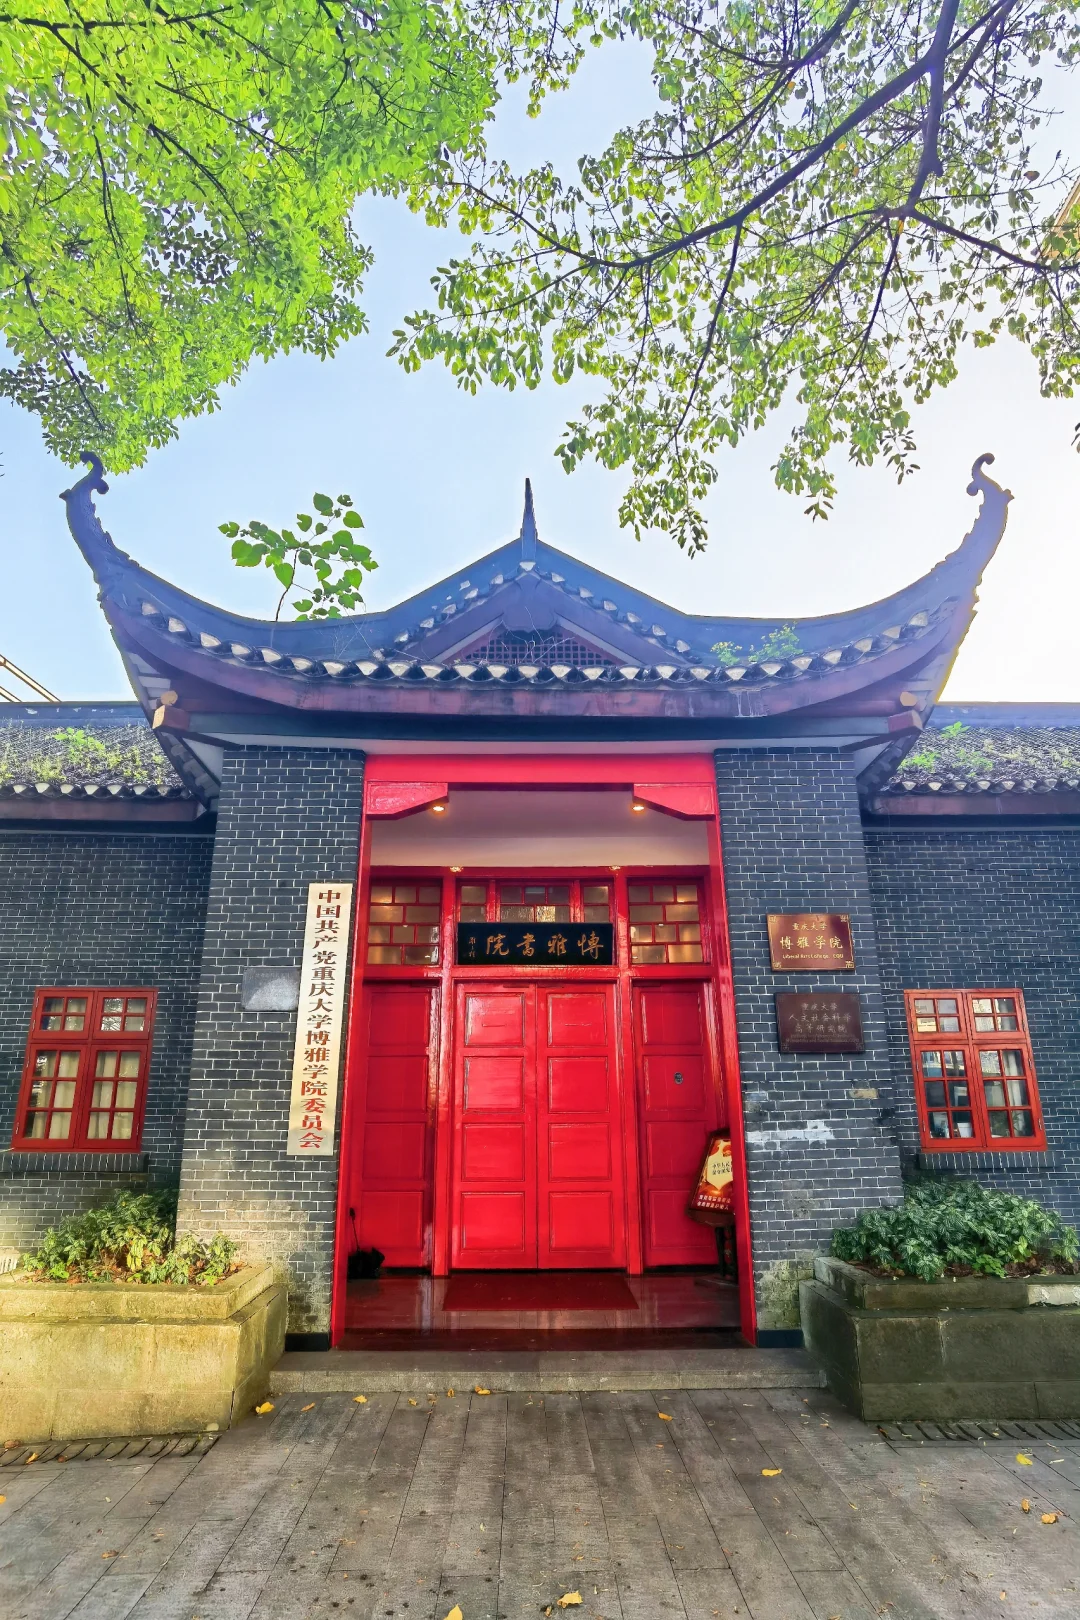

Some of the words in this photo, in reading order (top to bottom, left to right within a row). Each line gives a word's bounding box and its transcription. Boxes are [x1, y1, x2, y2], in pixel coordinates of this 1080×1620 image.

[792, 922, 827, 931] 重庆大学
[780, 935, 843, 950] 博雅学院
[801, 1002, 838, 1011] 重庆大学
[299, 889, 341, 1149] 中国共产党重庆大学博雅学院委员会
[788, 1013, 852, 1022] 人文社会科学
[795, 1024, 848, 1033] 高等研究院
